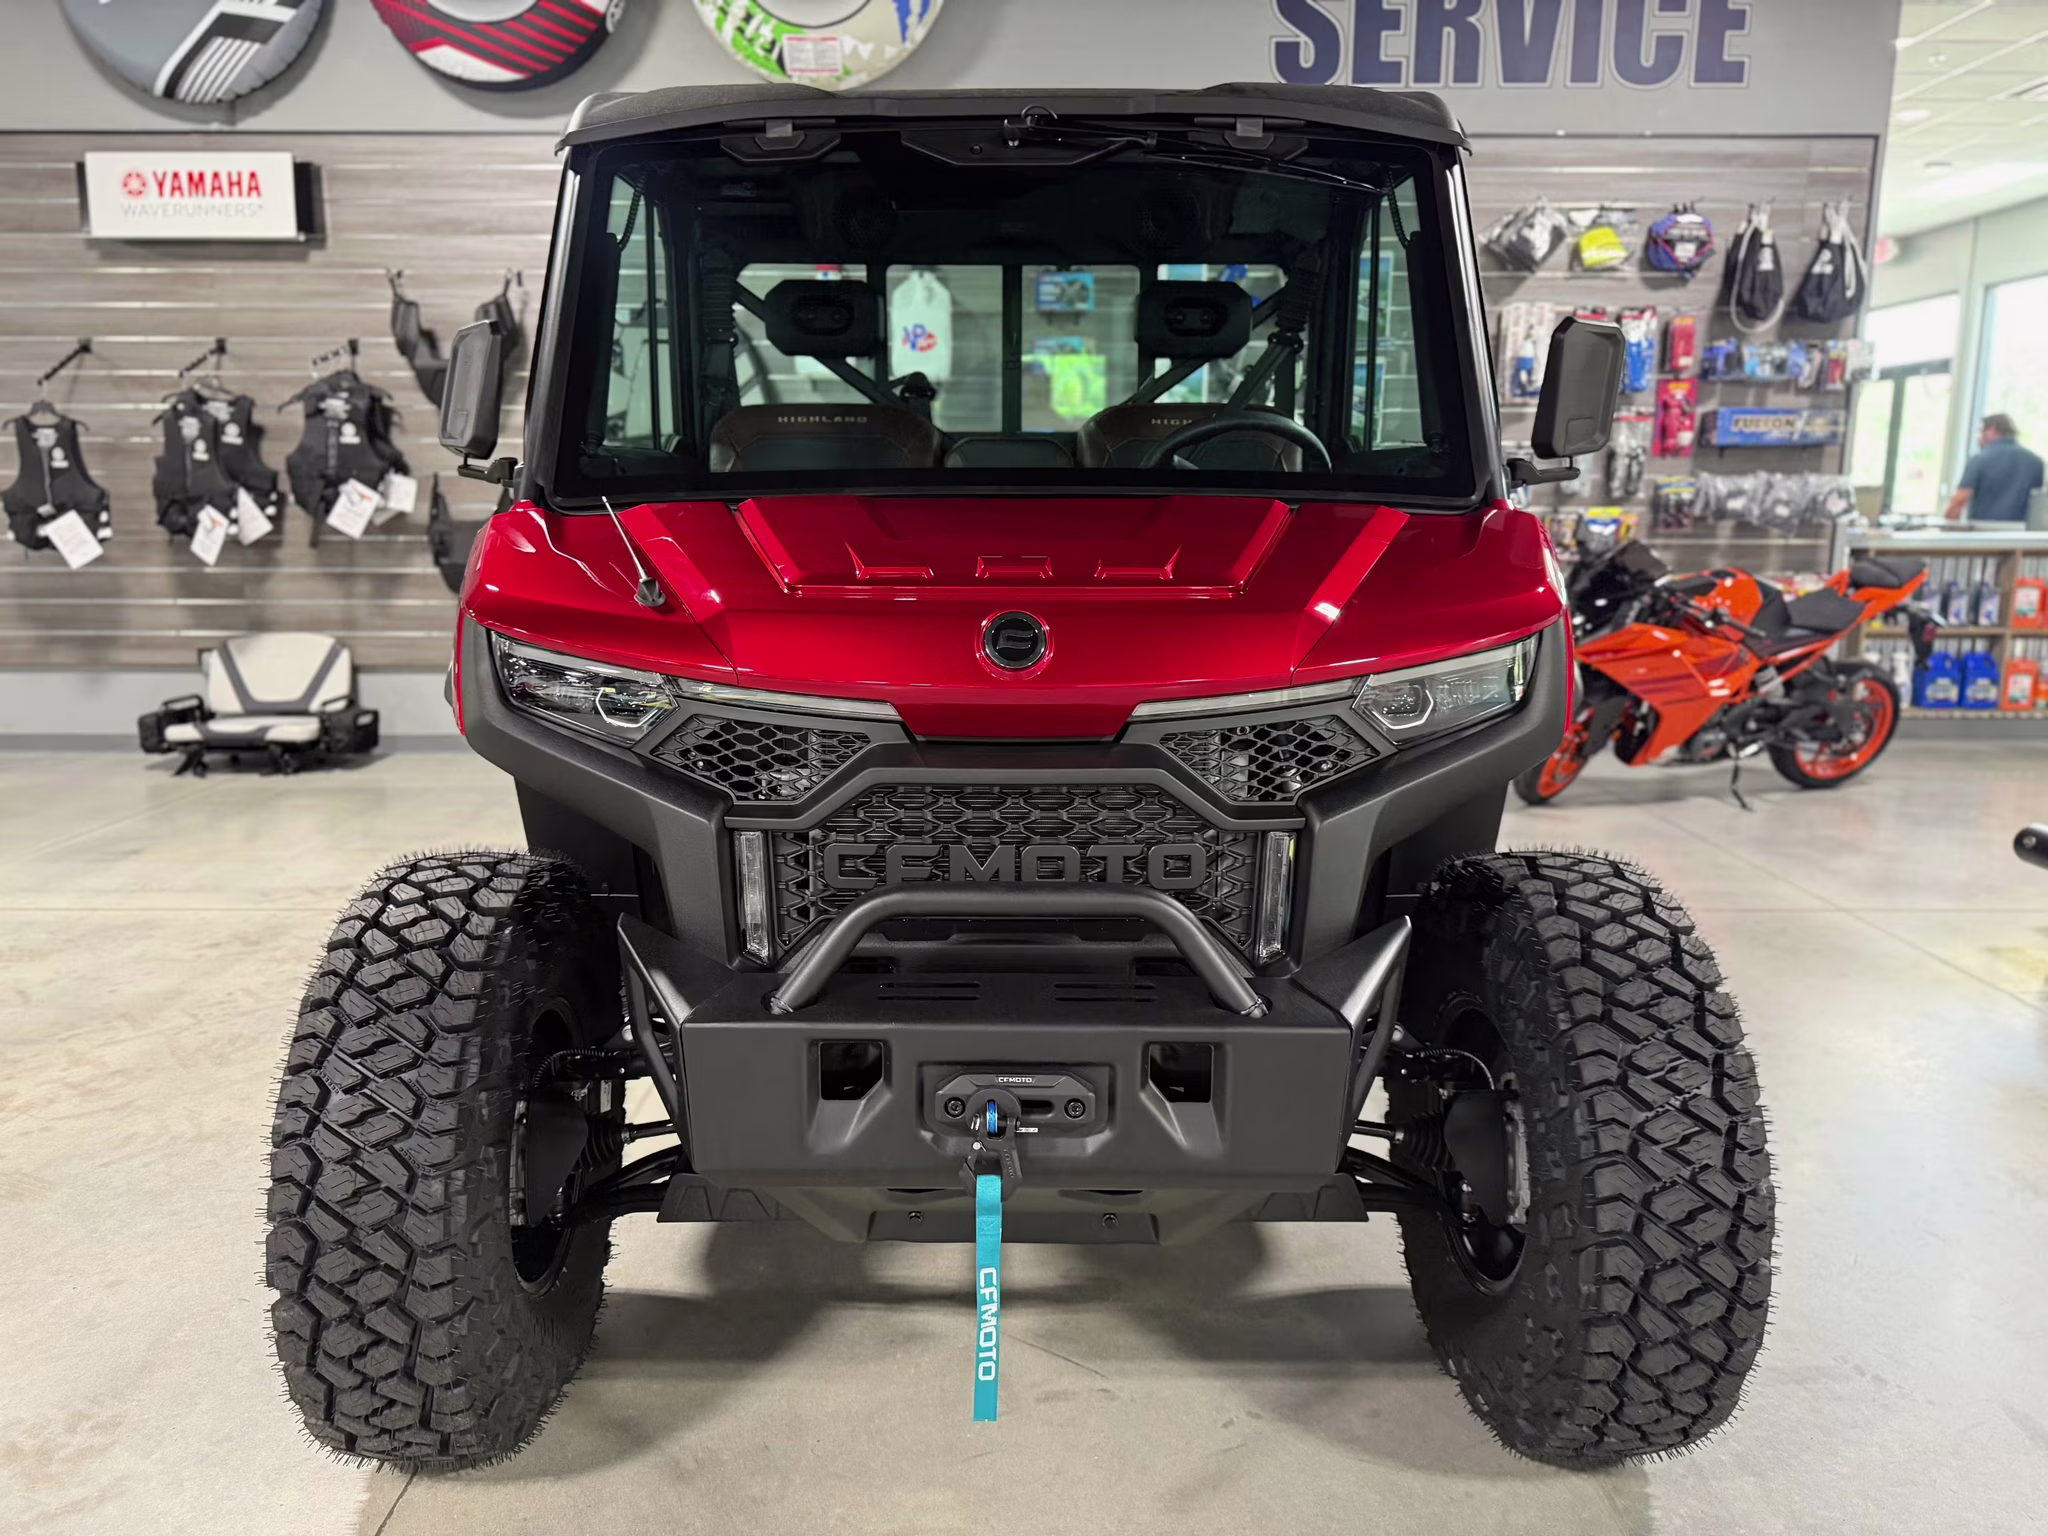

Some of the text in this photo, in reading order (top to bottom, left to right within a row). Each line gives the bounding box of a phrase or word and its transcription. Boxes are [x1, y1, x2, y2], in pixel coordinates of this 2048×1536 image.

[1271, 0, 1751, 89] SERVICE
[152, 170, 262, 198] YAMAHA
[823, 843, 1207, 890] CFMOTO
[978, 1267, 998, 1381] CFMOTO
